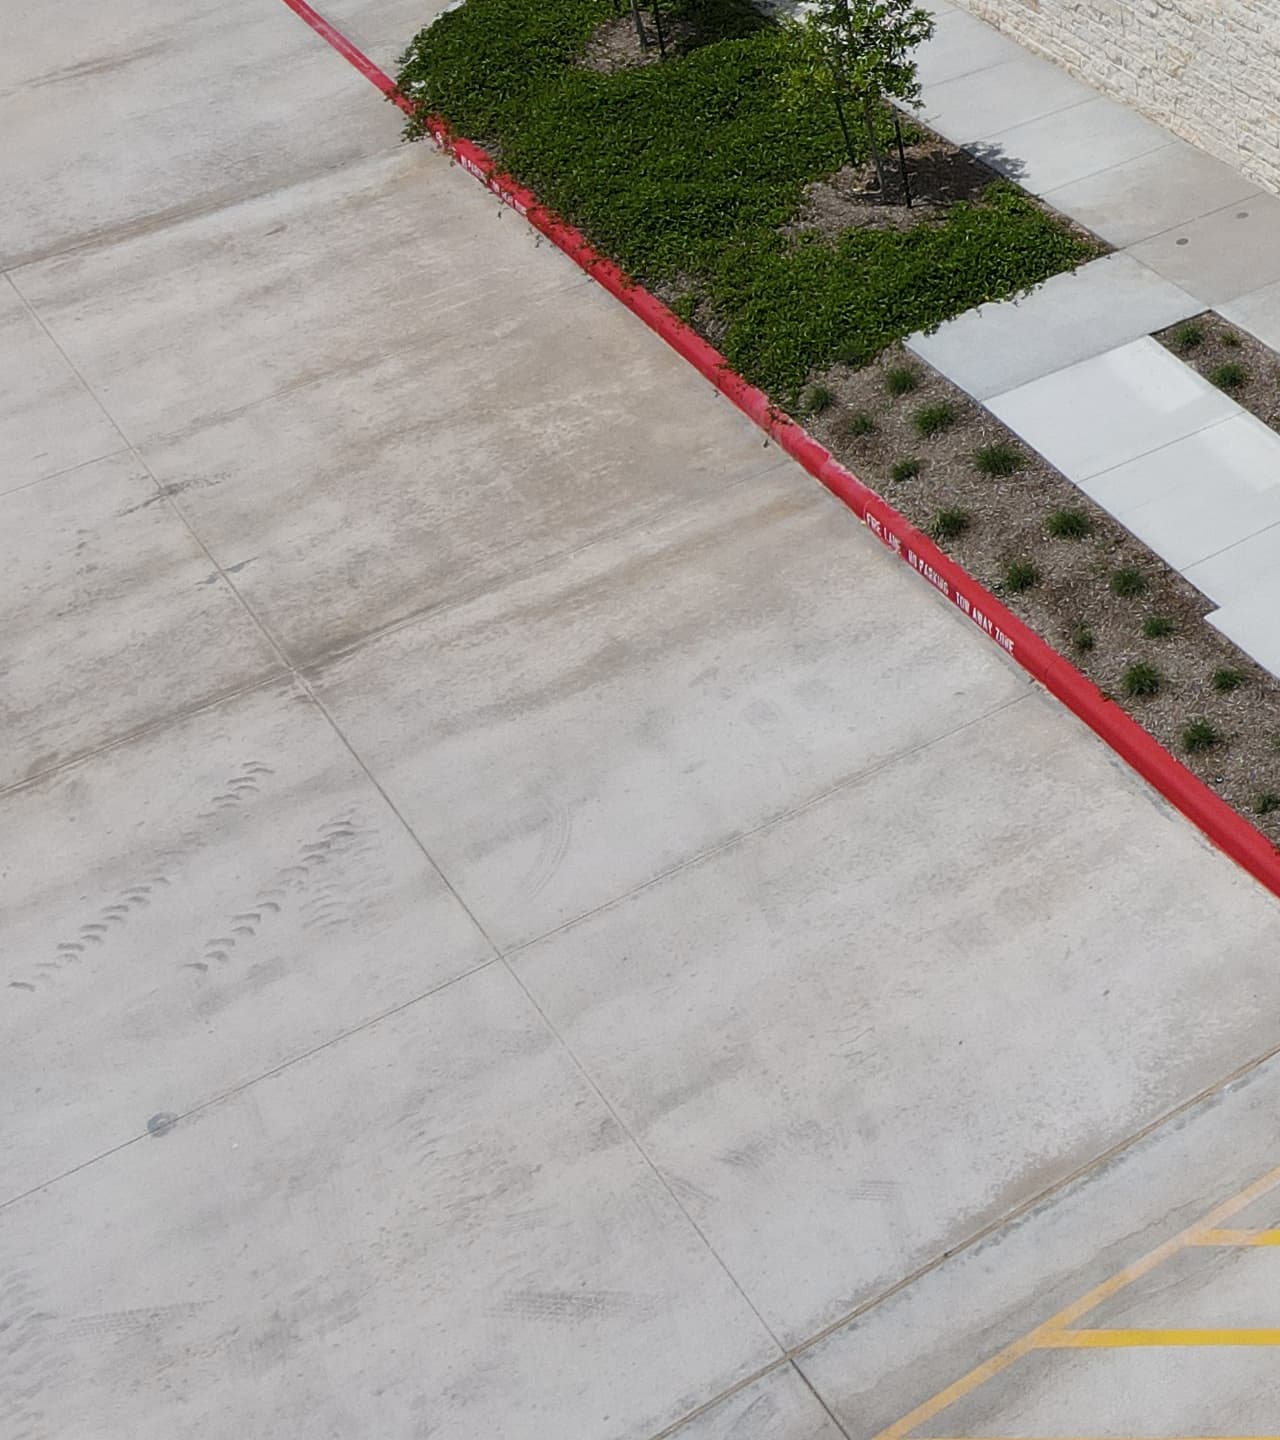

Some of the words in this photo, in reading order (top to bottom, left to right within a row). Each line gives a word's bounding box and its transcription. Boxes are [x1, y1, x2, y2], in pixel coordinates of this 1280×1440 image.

[908, 549, 917, 569] NO
[919, 560, 949, 596] PARKING
[955, 591, 970, 613] TOW
[972, 607, 993, 634] AWAY
[995, 627, 1014, 656] ZONE
